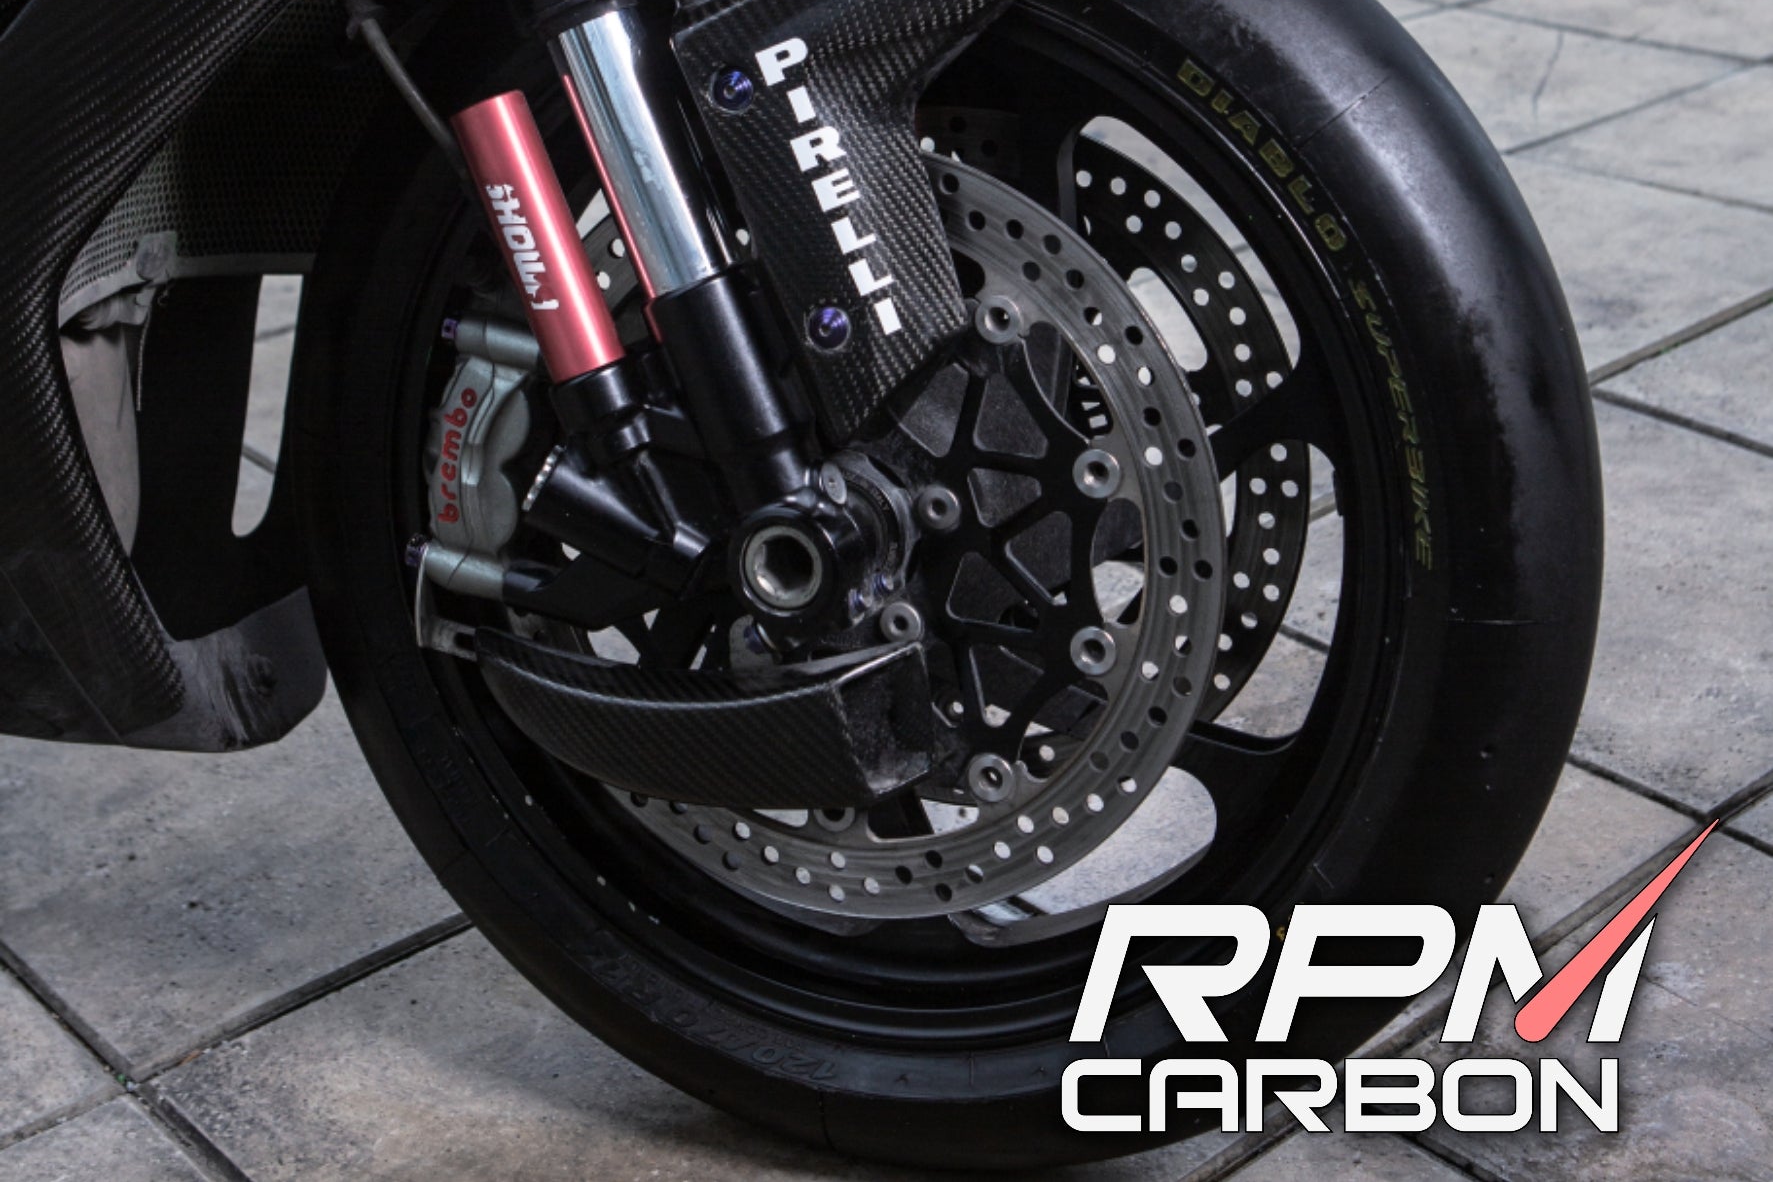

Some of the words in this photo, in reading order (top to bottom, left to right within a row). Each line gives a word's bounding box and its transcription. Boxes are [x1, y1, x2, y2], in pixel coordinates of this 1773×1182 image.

[755, 37, 902, 336] PIRELLI
[1177, 57, 1348, 252] DIABLO
[1349, 277, 1433, 570] SUPERBIKE
[437, 387, 478, 524] brembo
